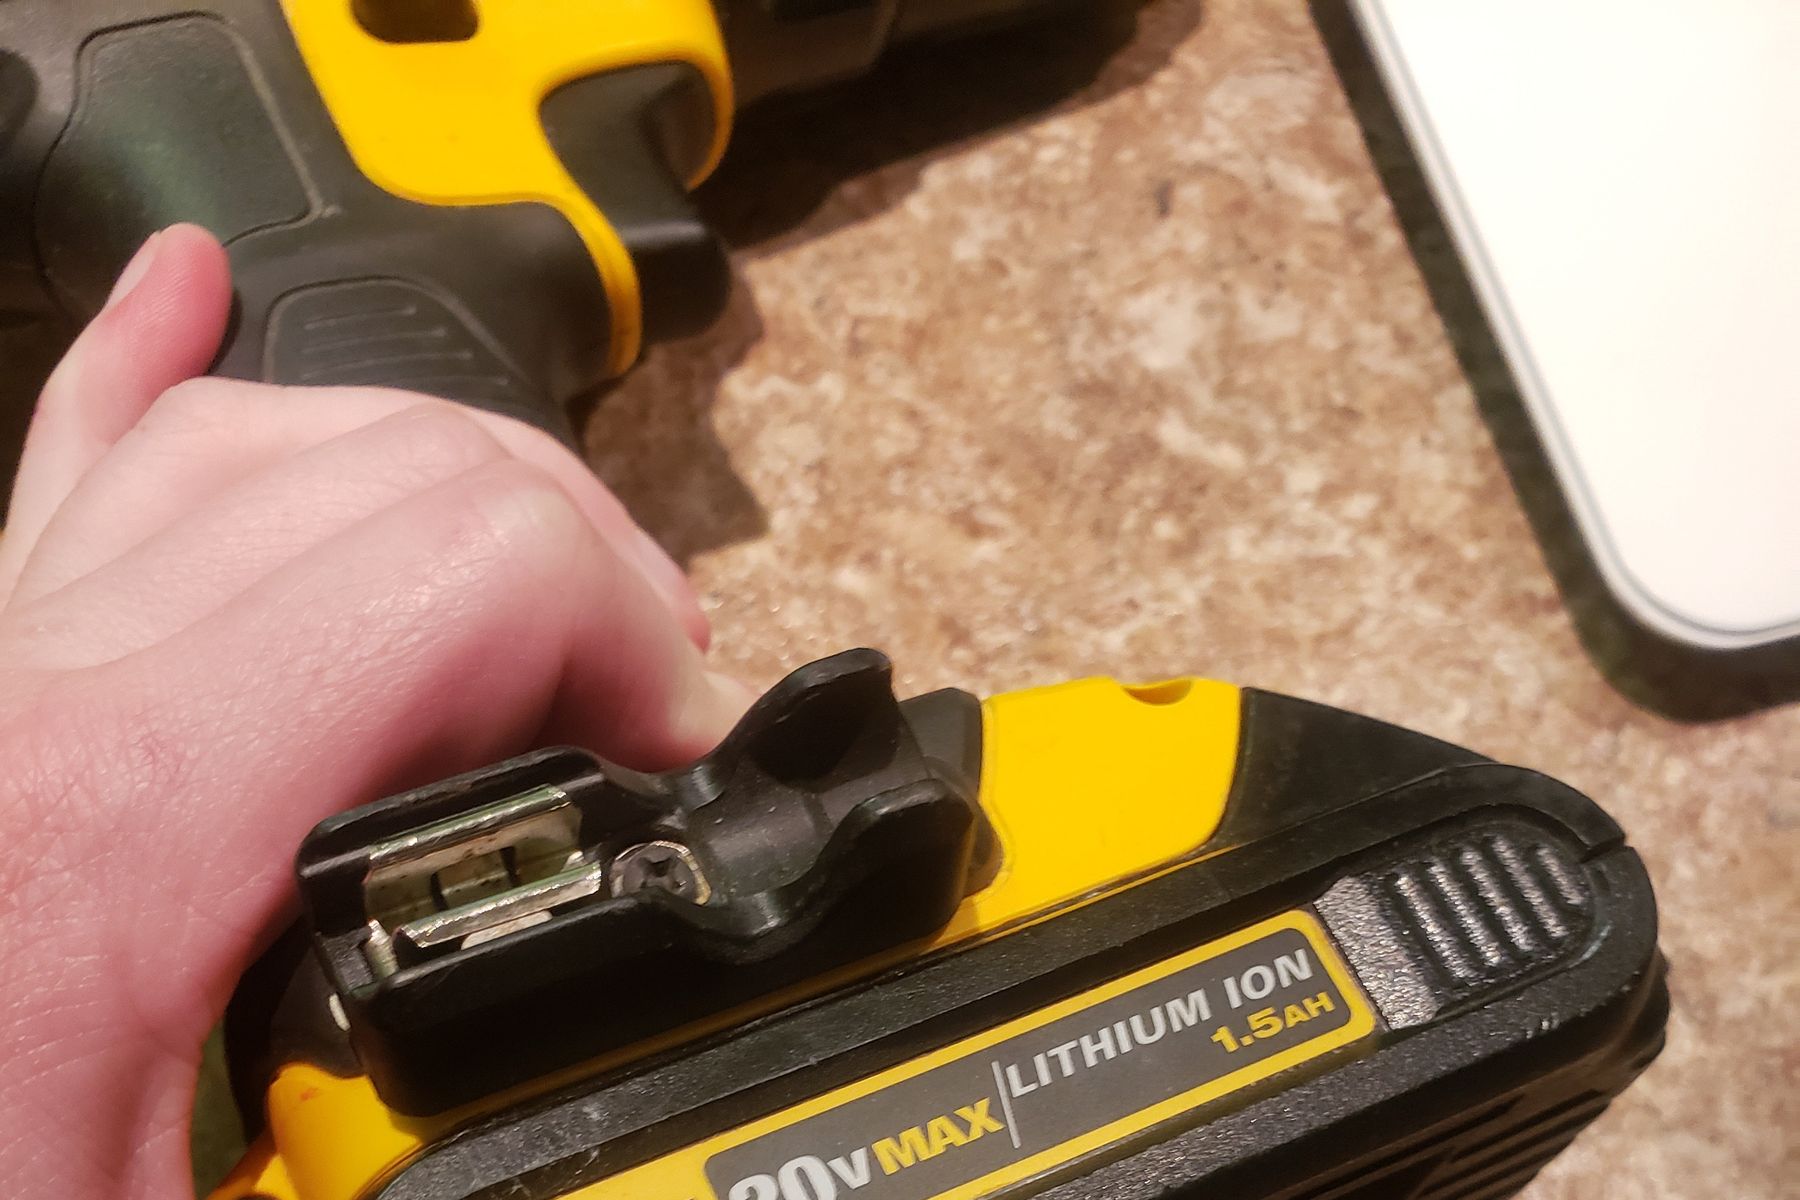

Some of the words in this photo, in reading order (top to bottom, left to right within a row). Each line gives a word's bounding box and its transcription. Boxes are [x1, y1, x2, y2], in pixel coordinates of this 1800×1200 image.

[1005, 988, 1212, 1098] LITHIUM
[1223, 948, 1314, 1009] ION
[871, 1097, 1006, 1176] MAX
